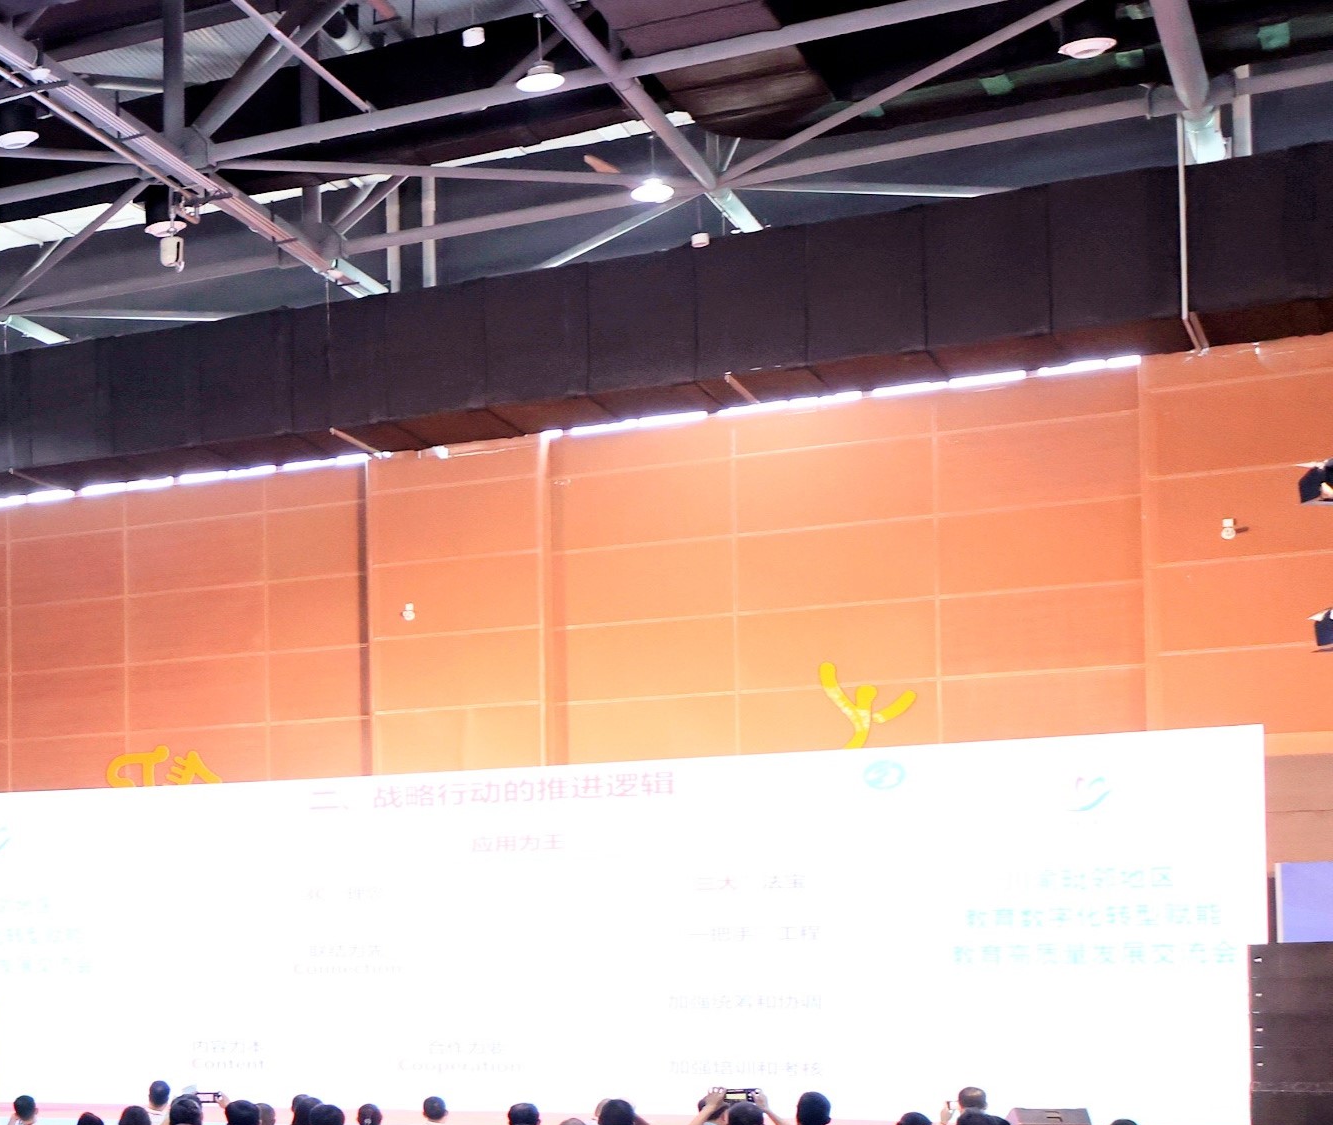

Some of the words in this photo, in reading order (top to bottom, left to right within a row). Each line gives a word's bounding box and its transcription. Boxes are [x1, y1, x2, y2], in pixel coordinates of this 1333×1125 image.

[310, 771, 676, 811] 二、战略行动的推进逻辑
[471, 833, 565, 853] 应用为王
[191, 1057, 265, 1070] Content
